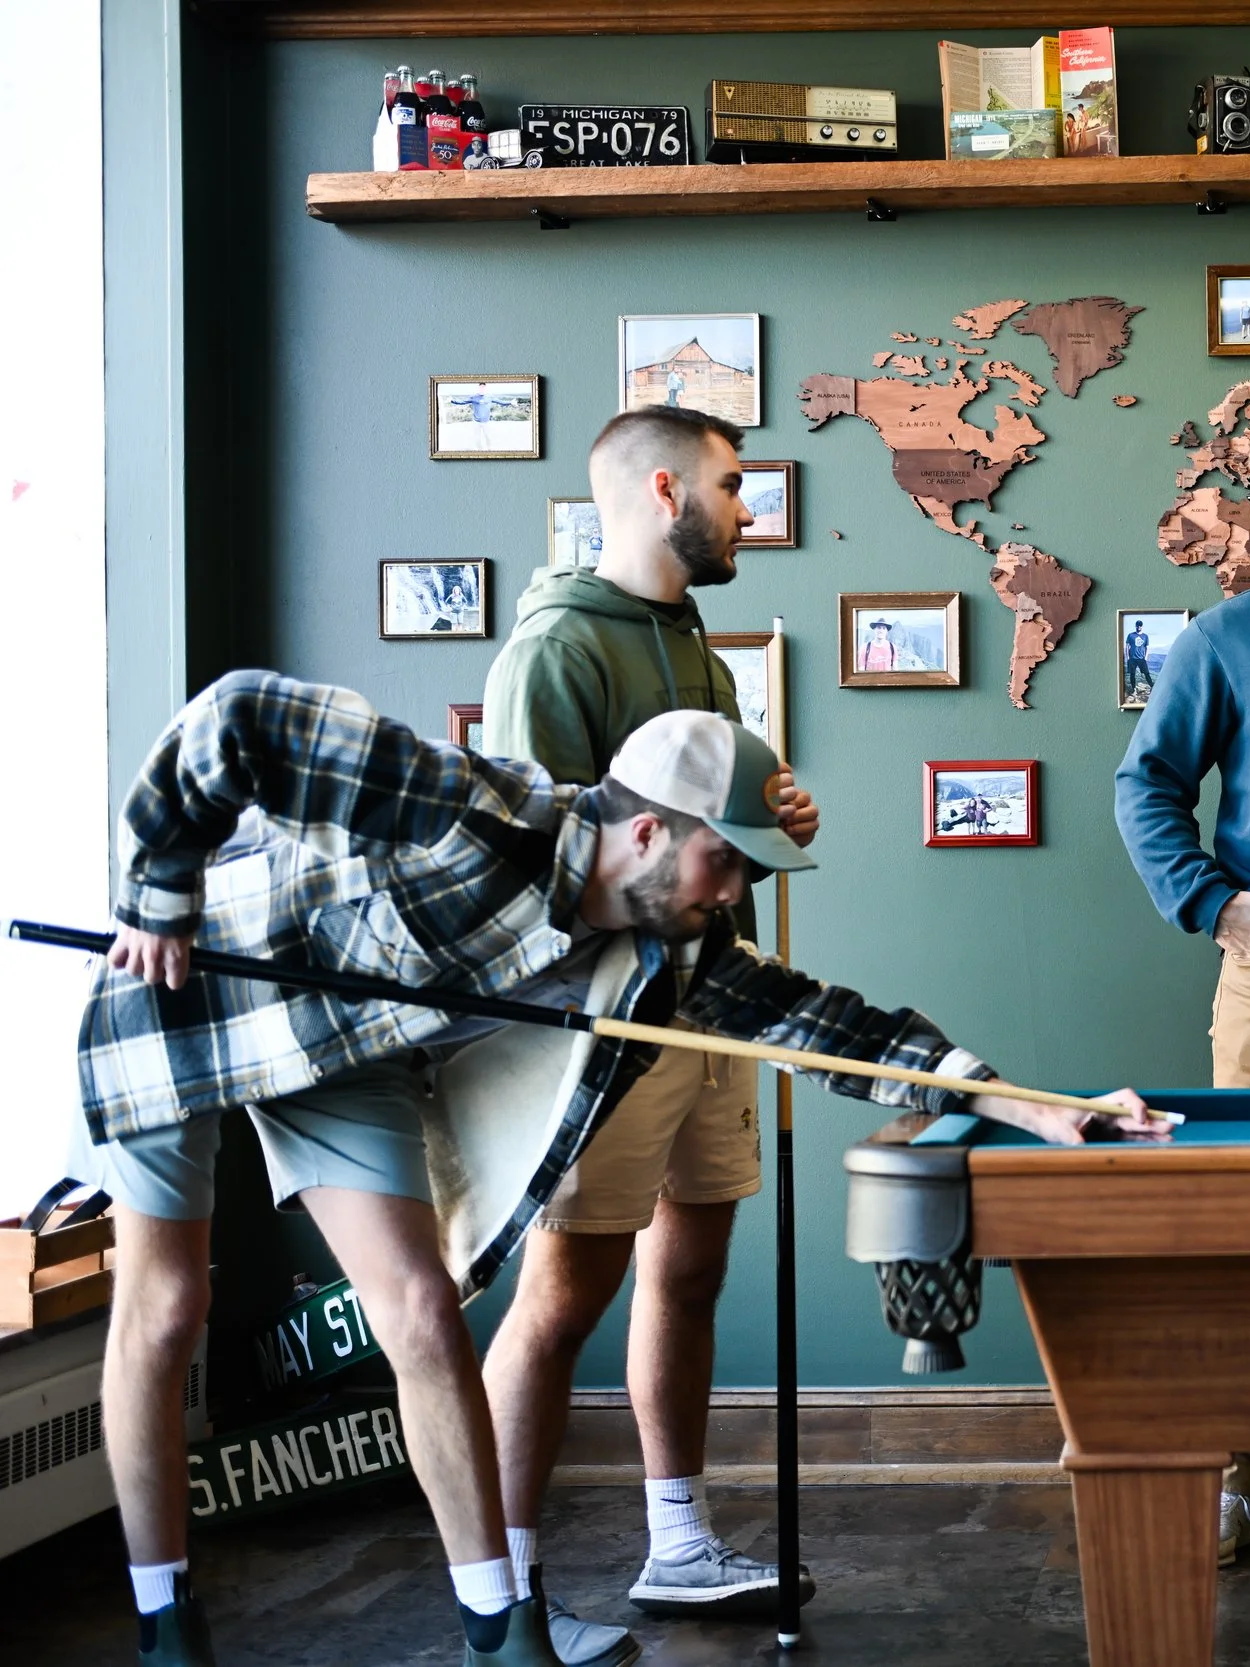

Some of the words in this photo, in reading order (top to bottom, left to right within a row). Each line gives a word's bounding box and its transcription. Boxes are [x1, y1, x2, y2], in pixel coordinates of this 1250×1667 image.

[1060, 48, 1094, 59] Southern
[1068, 54, 1108, 67] California
[531, 109, 545, 118] 19
[563, 109, 645, 120] MICHIGAN
[661, 111, 678, 120] 79
[431, 118, 457, 128] Coca-Cola
[439, 150, 452, 160] 50
[946, 470, 971, 478] STATES
[254, 1311, 314, 1392] MAY
